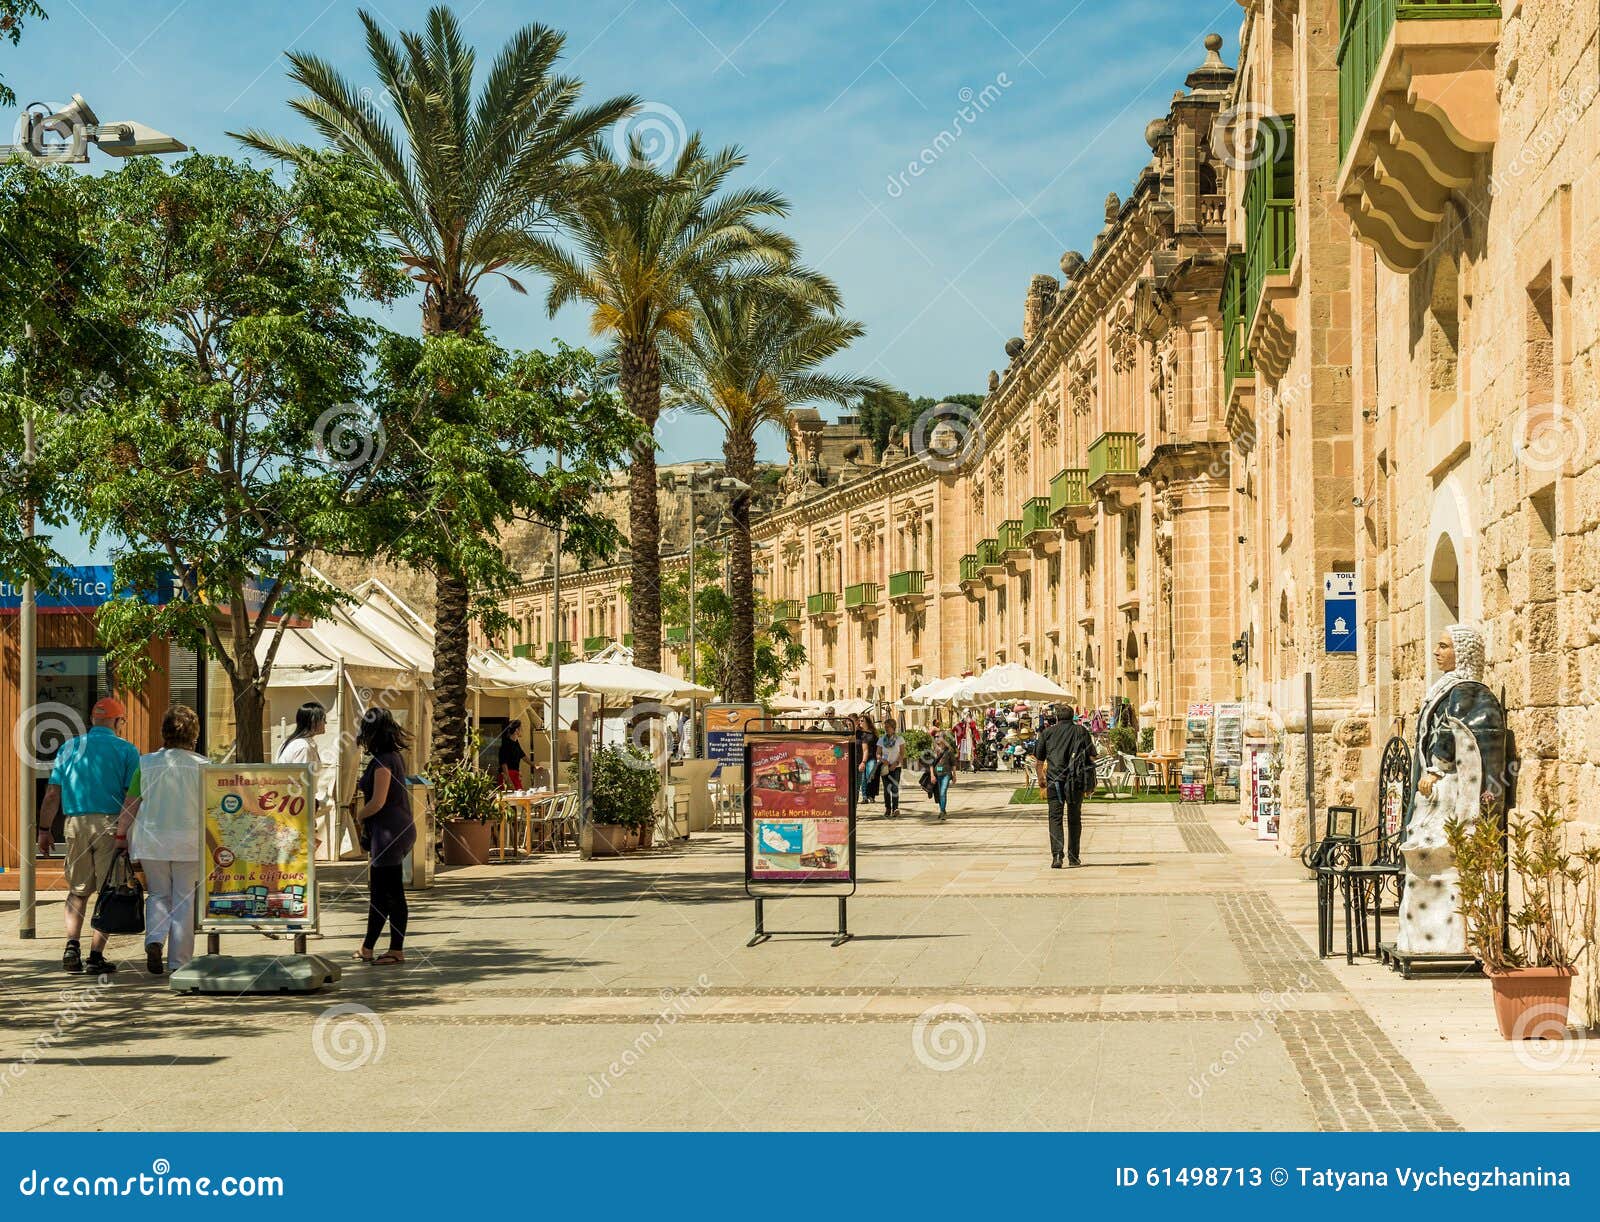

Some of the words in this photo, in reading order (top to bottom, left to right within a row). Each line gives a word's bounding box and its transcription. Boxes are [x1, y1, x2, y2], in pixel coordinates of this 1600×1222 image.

[257, 790, 306, 816] €10
[753, 809, 779, 817] Valletta
[789, 809, 810, 817] North
[811, 809, 833, 817] Route
[208, 871, 229, 882] Hop
[233, 873, 245, 881] on
[248, 872, 257, 881] &
